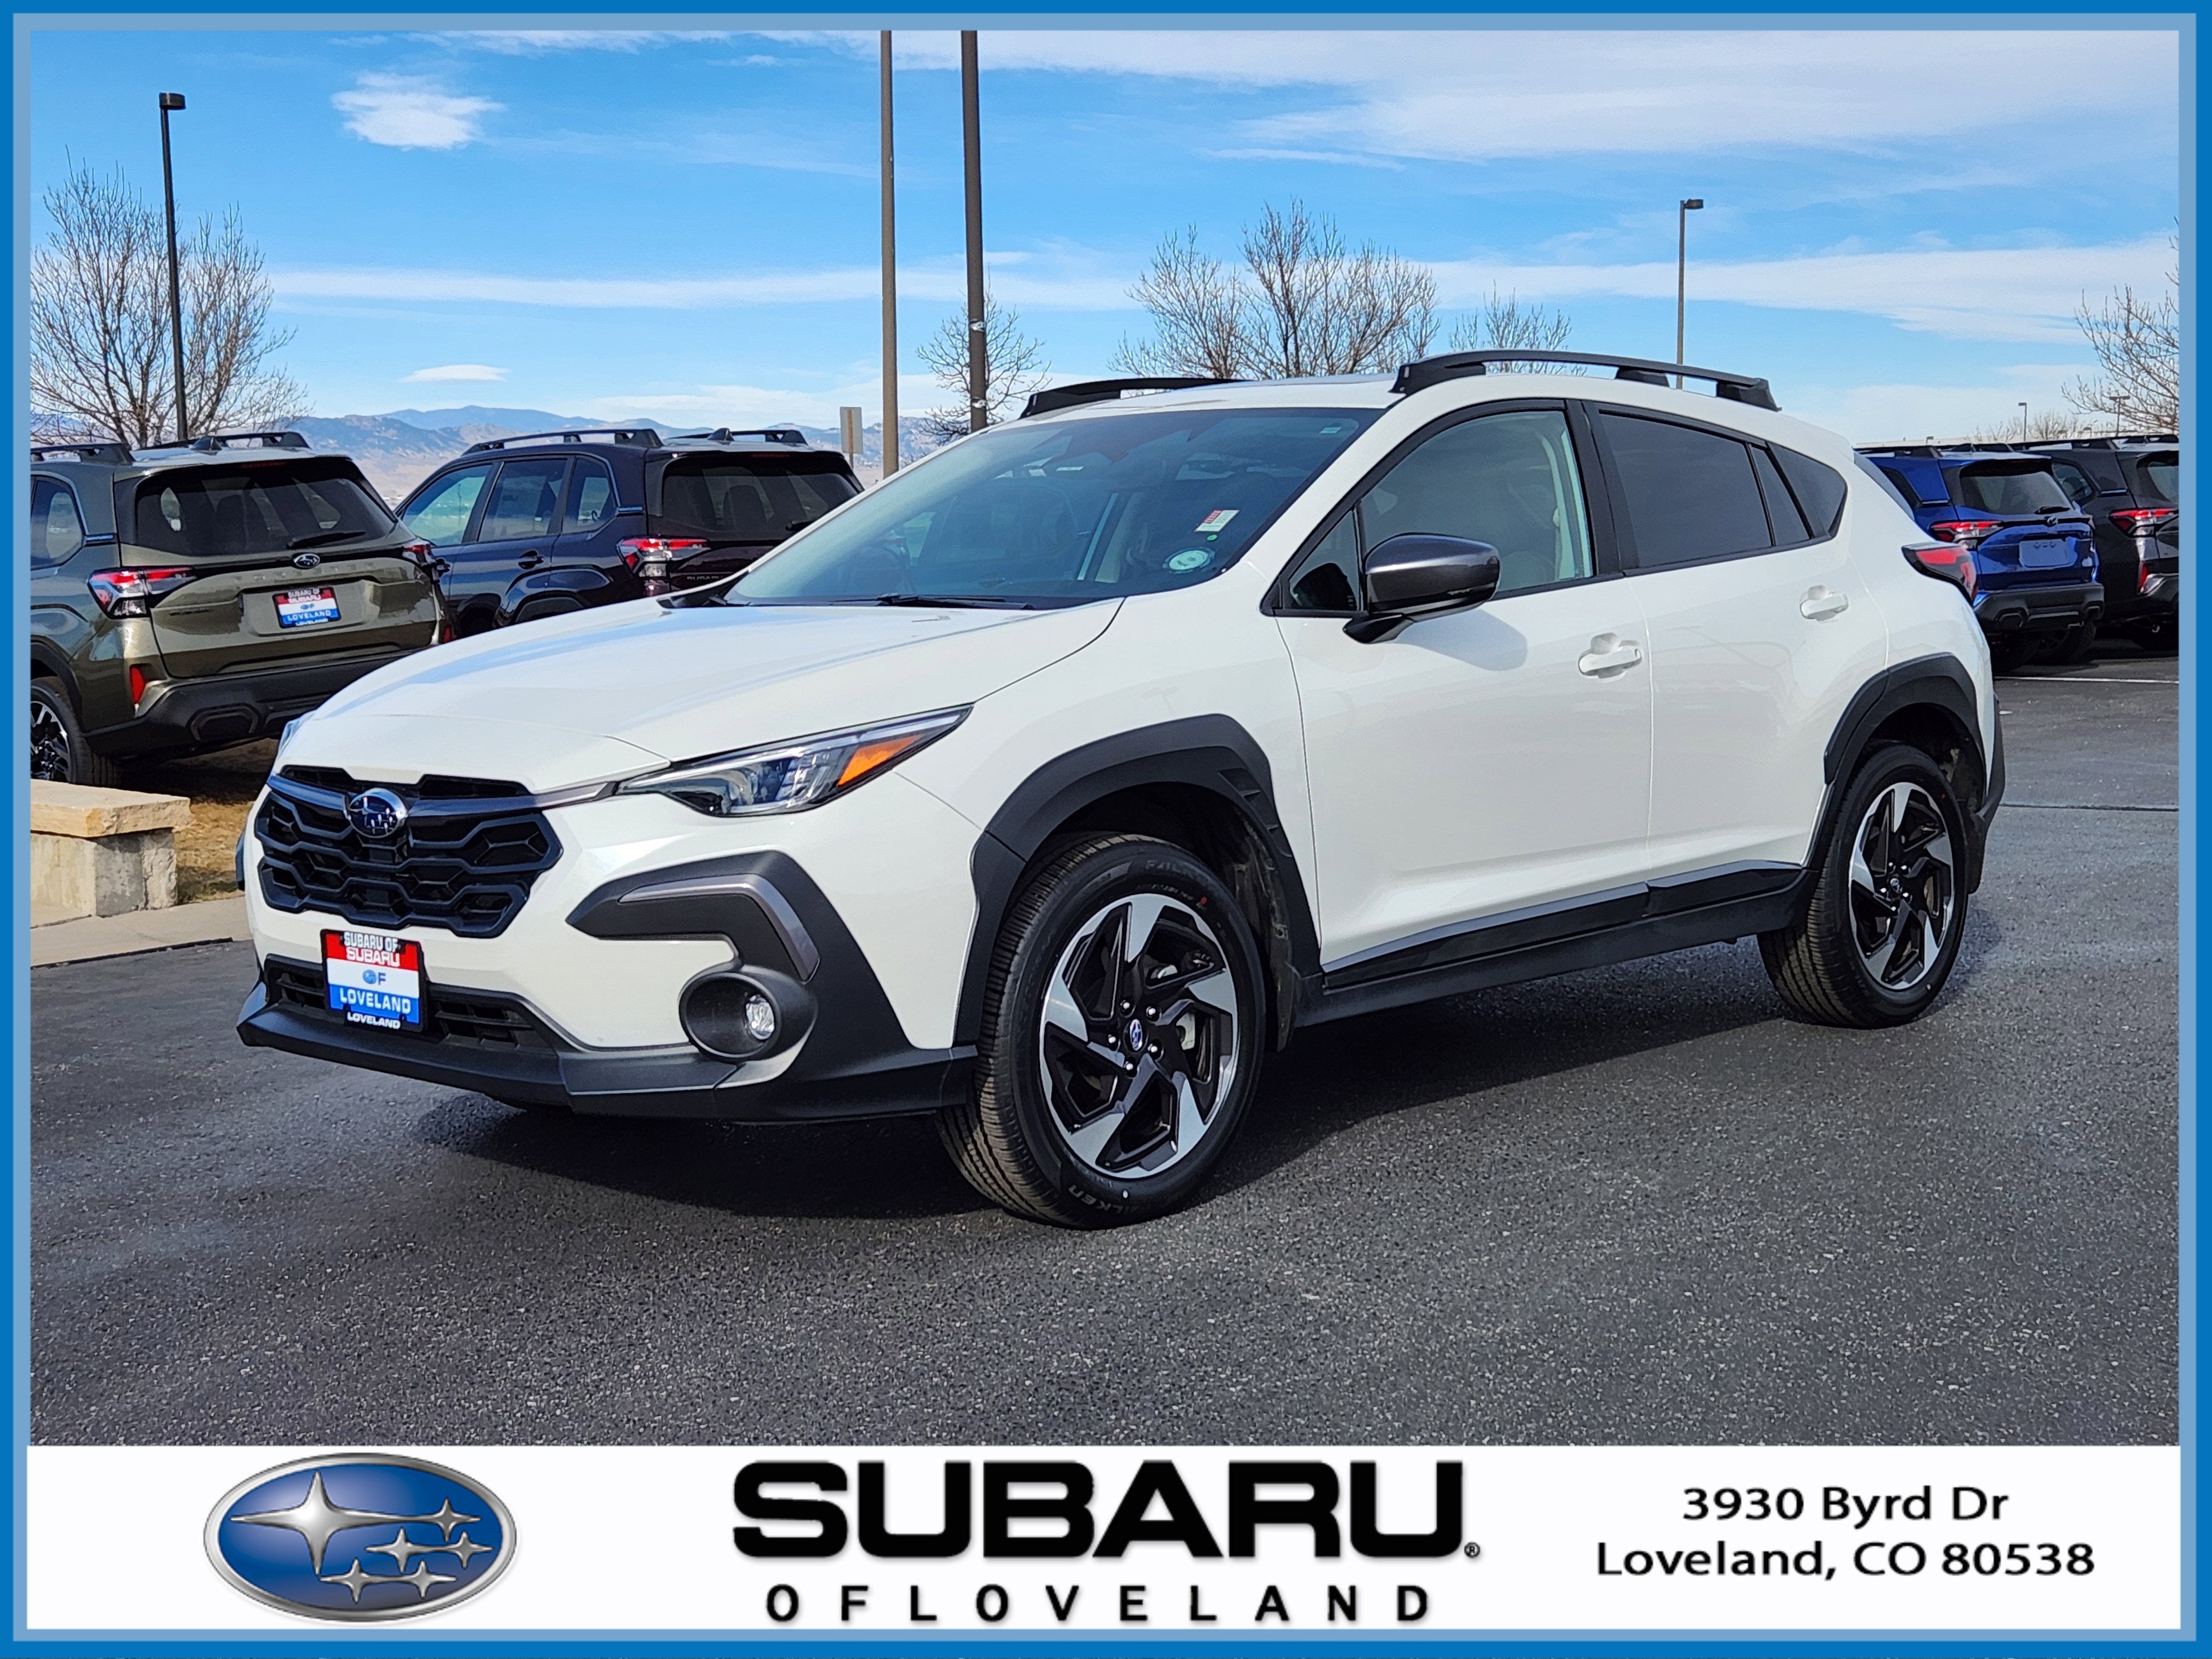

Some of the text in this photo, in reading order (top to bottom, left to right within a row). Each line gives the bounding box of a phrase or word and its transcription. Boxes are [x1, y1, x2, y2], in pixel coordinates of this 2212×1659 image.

[287, 609, 332, 622] LOVELAND
[343, 931, 399, 953] SUBARU OF
[346, 947, 400, 967] SUBARU
[362, 969, 387, 986] OF
[340, 987, 411, 1015] LOVELAND
[347, 1011, 401, 1030] LOVELAND
